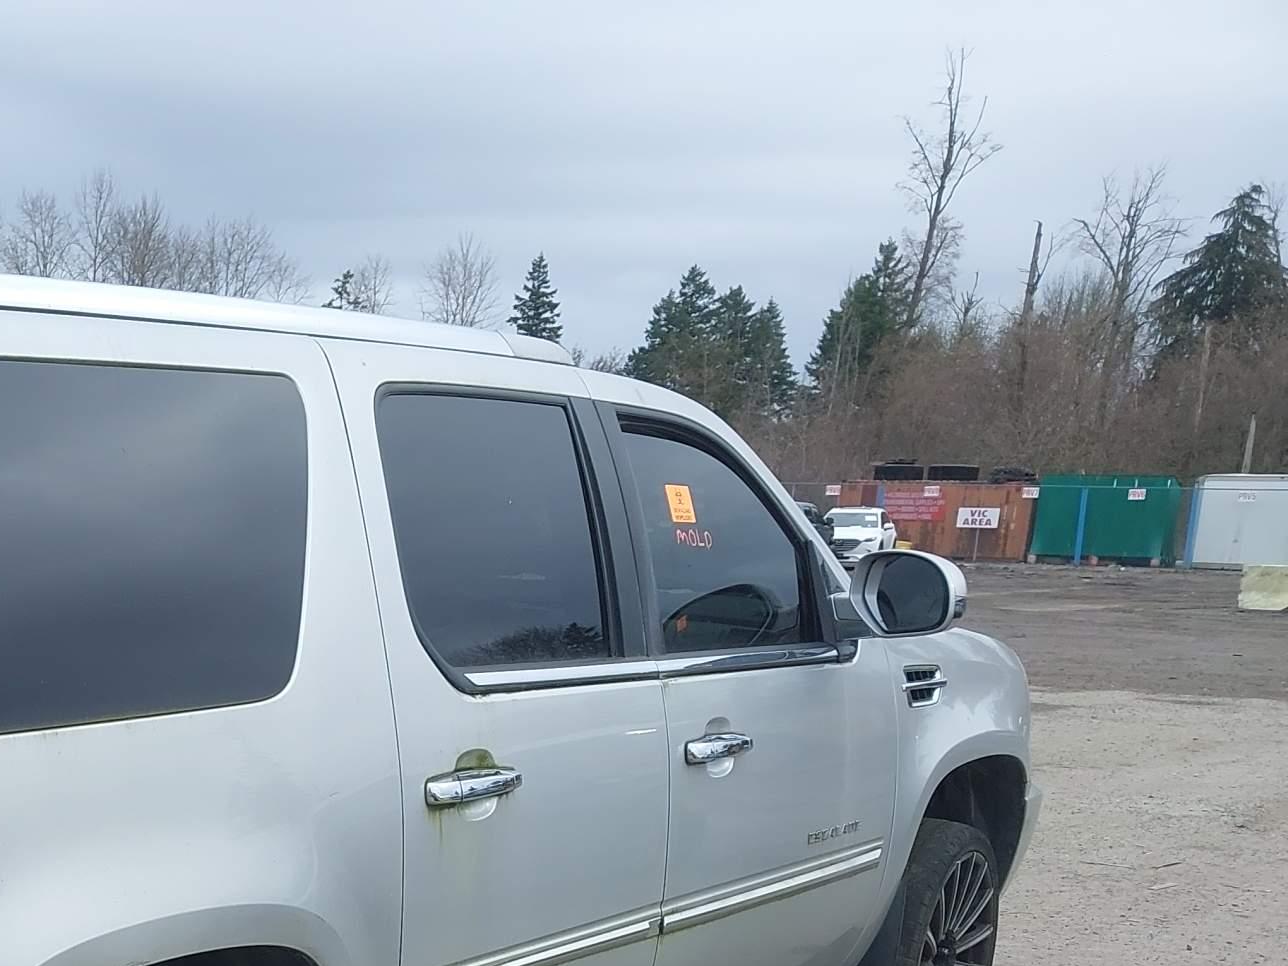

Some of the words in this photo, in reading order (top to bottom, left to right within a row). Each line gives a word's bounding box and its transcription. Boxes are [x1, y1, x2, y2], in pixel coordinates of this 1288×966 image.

[970, 510, 988, 518] VIC
[962, 518, 993, 527] AREA
[676, 528, 713, 551] MOLD
